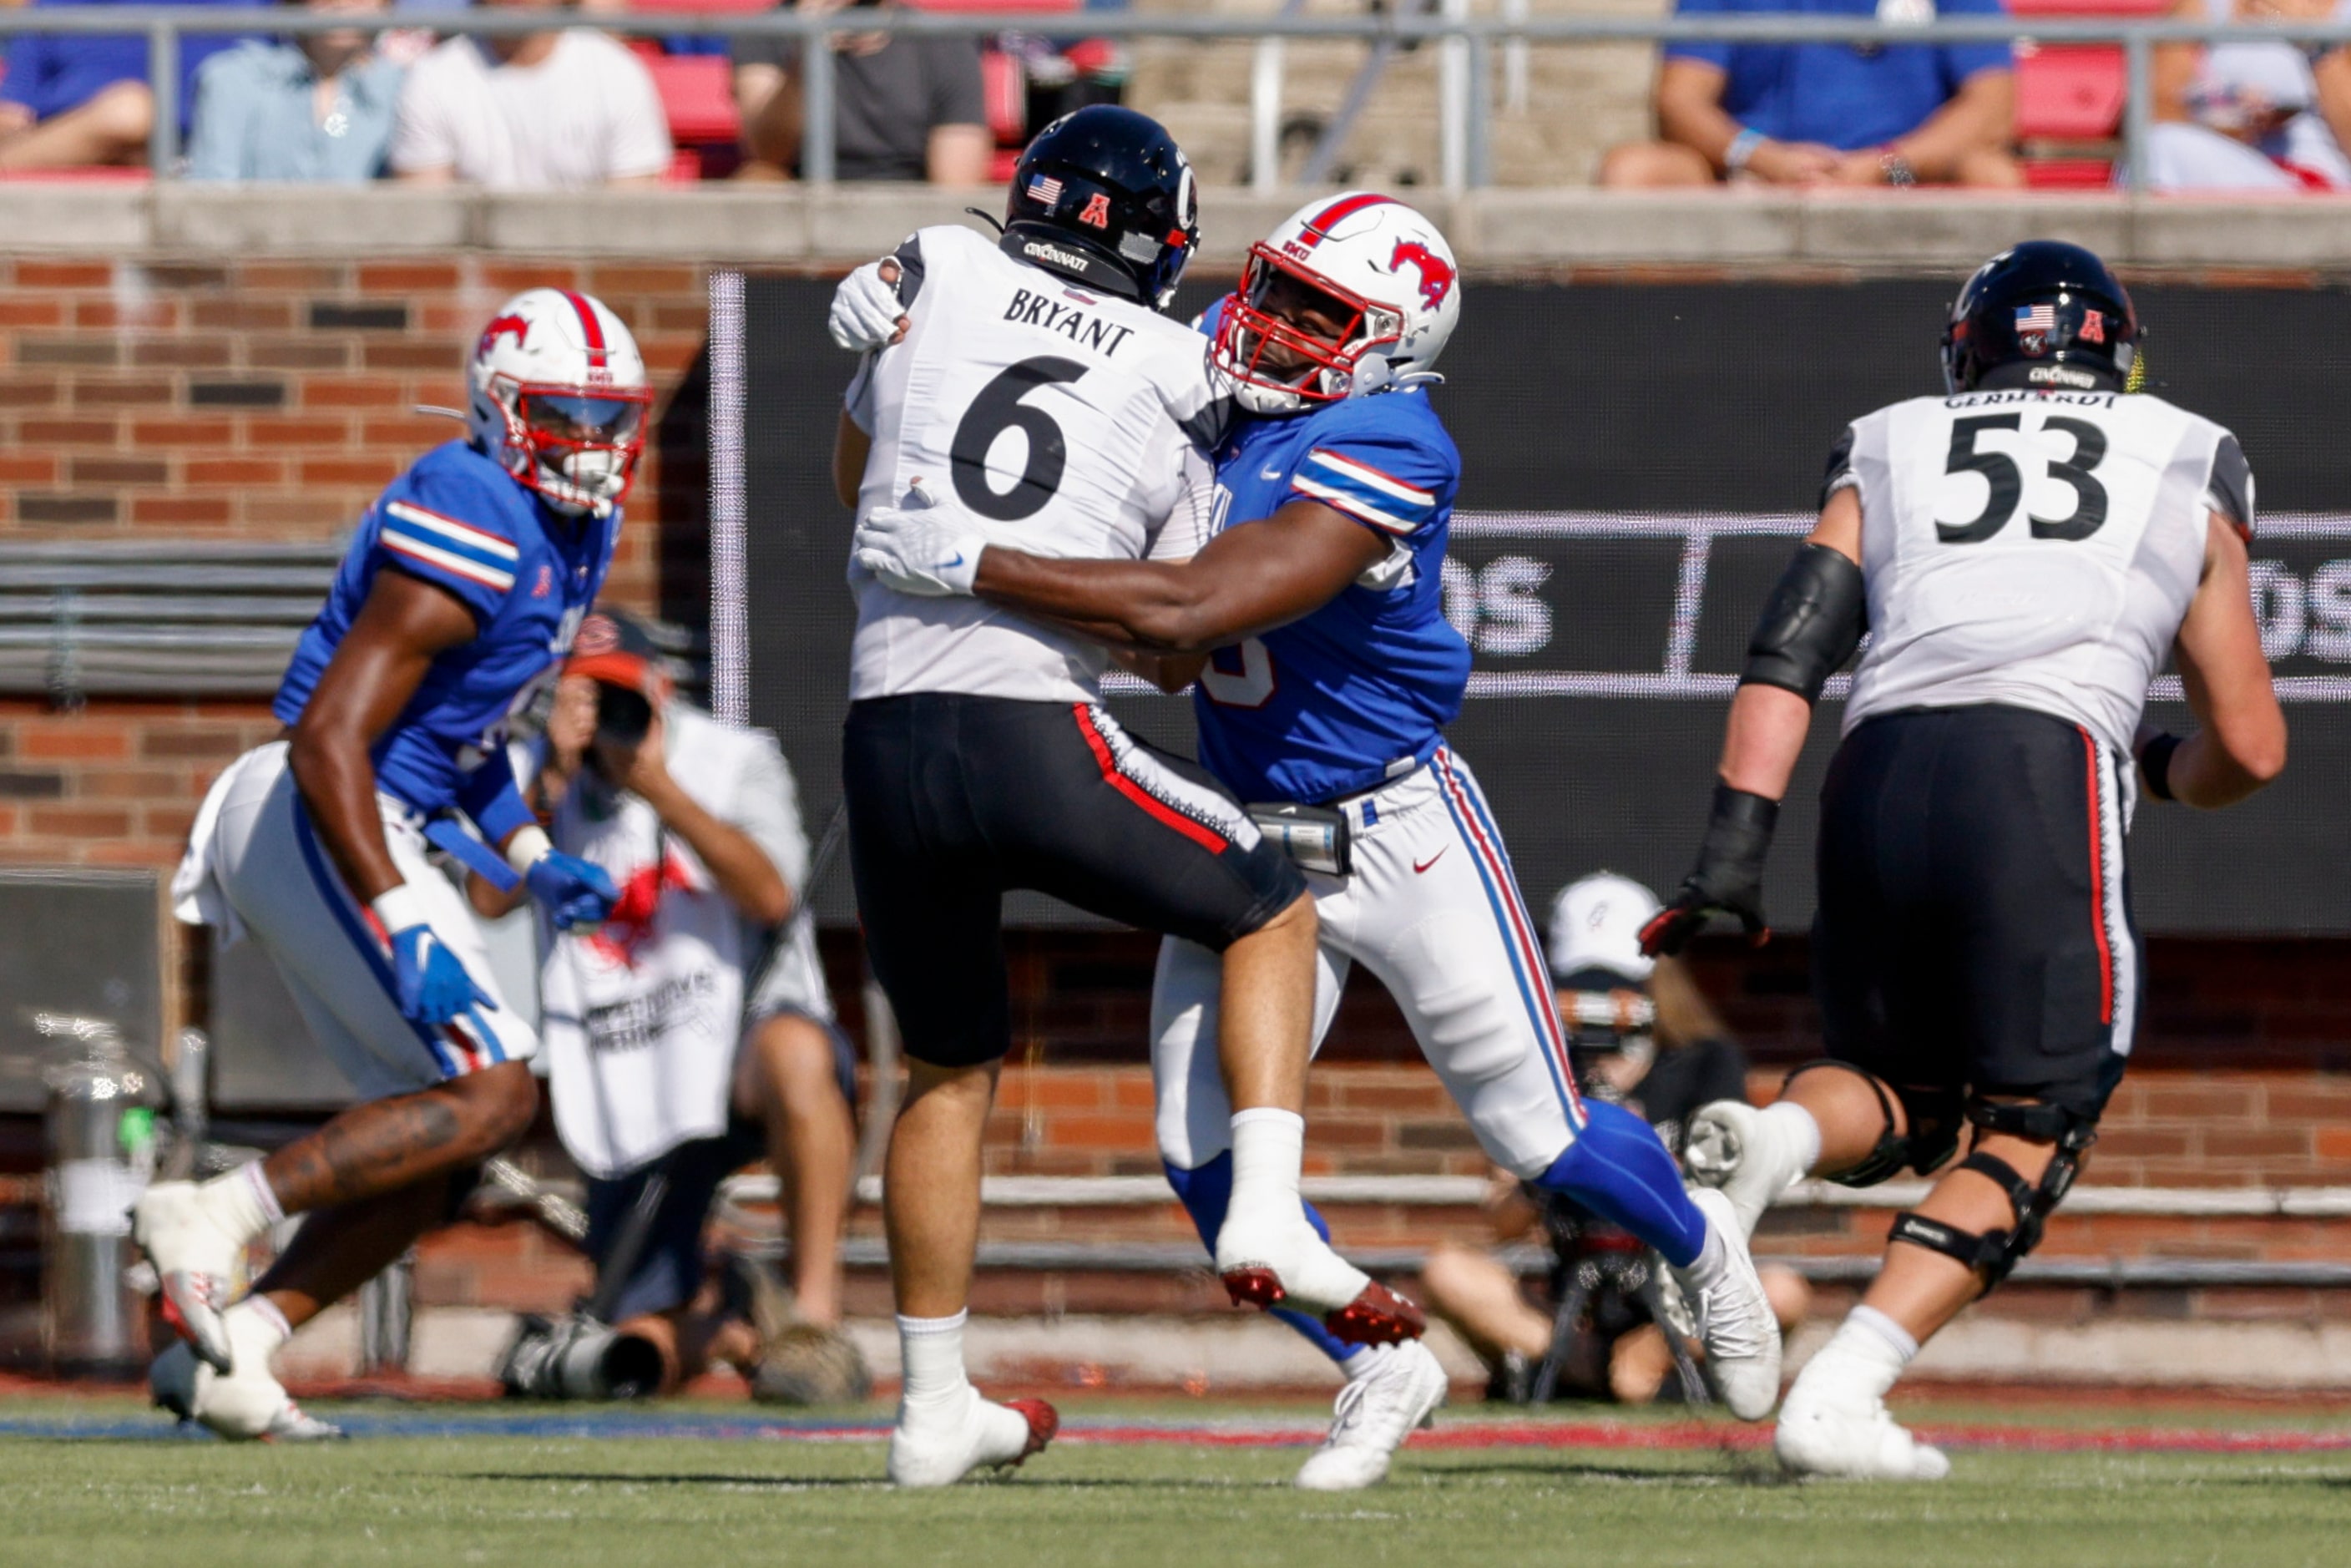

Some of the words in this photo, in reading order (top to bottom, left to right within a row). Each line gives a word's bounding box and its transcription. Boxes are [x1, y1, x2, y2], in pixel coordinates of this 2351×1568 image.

[1024, 241, 1089, 272] CINCINNATI
[1003, 288, 1135, 358] BRYANT
[950, 355, 1090, 521] 6
[1934, 412, 2109, 545] 53
